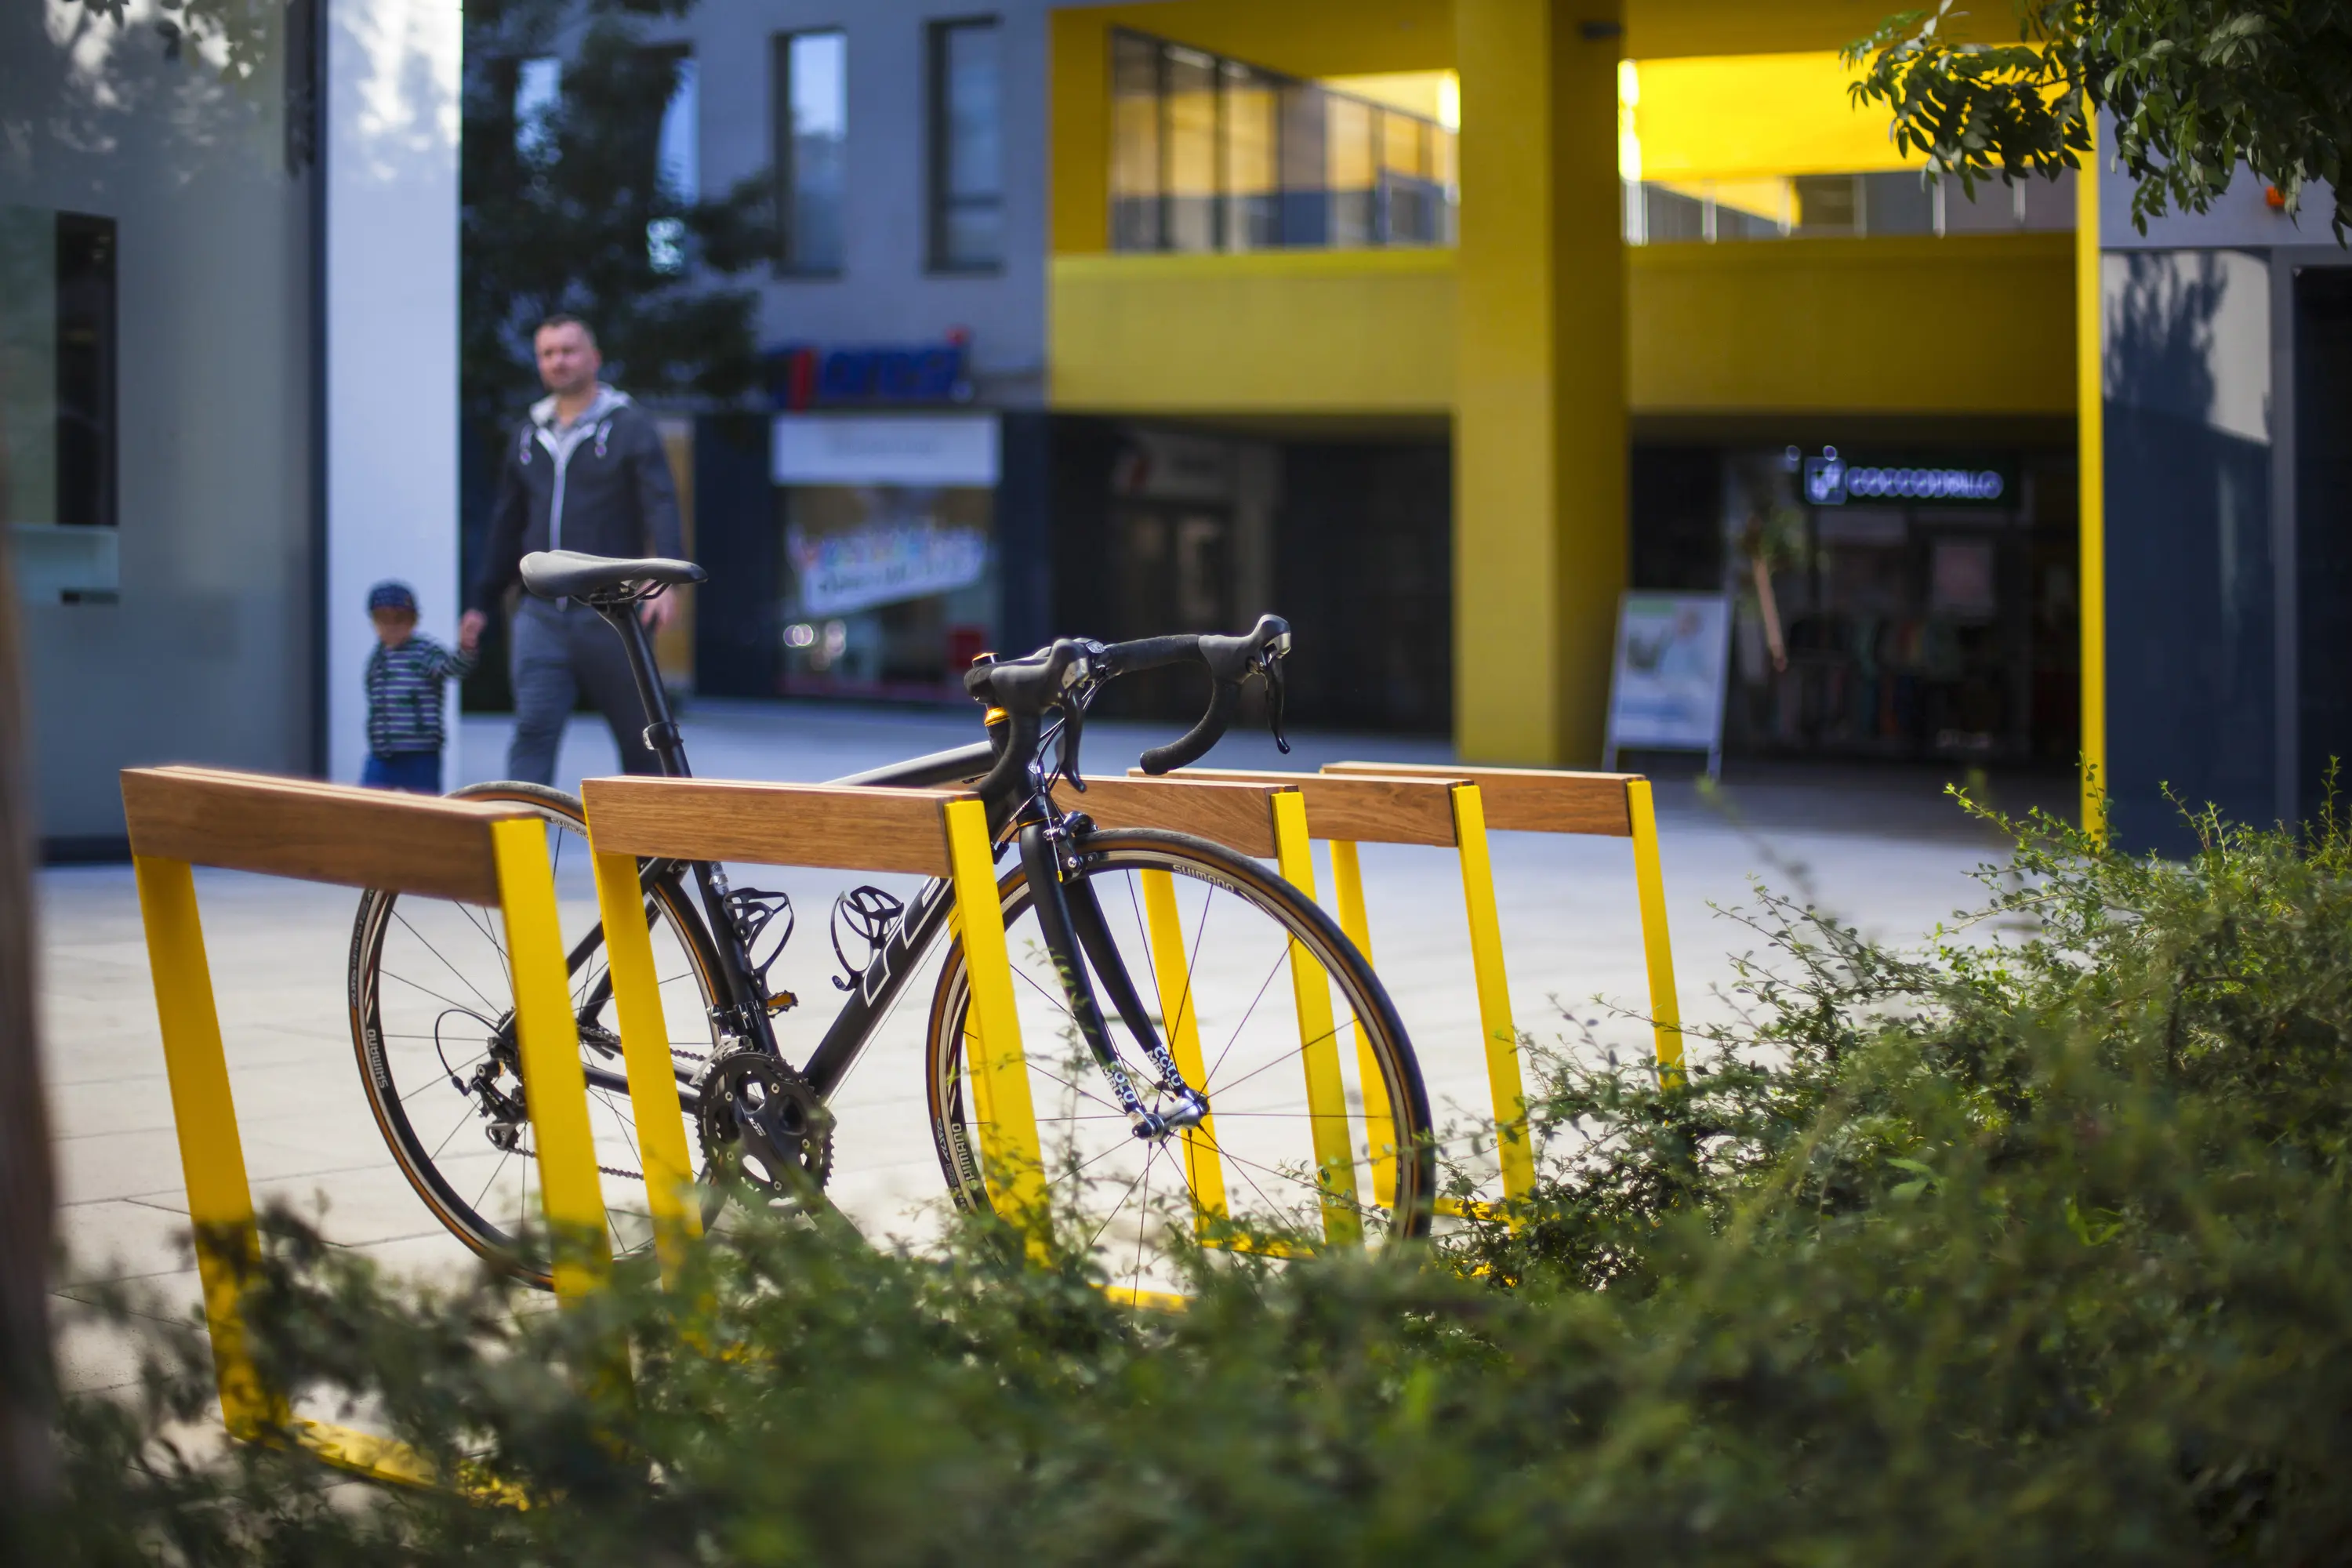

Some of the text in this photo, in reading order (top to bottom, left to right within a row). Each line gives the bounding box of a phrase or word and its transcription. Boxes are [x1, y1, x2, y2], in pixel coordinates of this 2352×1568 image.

[1172, 864, 1235, 893] SHIMANO
[367, 1029, 389, 1088] SHIMANO
[951, 1123, 979, 1183] HIMANO
